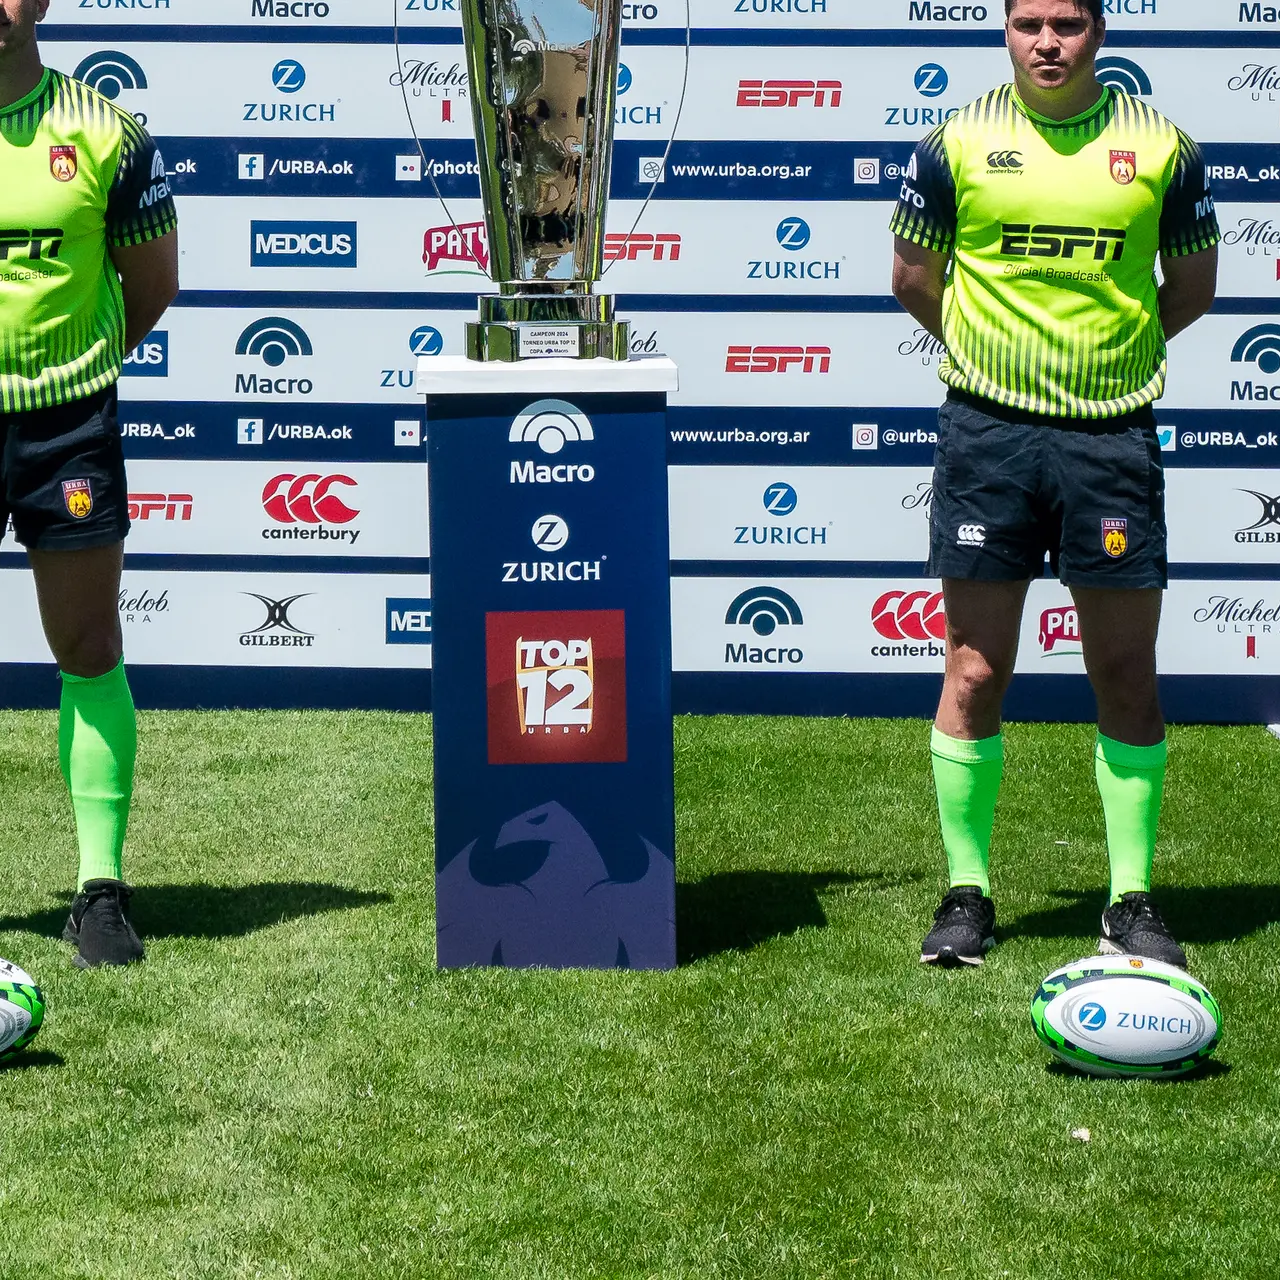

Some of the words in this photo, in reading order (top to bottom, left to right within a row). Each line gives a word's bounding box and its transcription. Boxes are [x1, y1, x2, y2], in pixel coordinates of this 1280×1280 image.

[908, 0, 988, 22] Macro
[736, 80, 842, 108] ESPN
[242, 102, 335, 122] ZURICH
[268, 158, 355, 177] /URBA.ok
[671, 159, 812, 180] www.urba.org.ar
[254, 233, 352, 256] MEDICUS
[1000, 223, 1127, 262] ESPN
[747, 261, 840, 280] ZURICH
[1003, 263, 1044, 279] Official
[1045, 267, 1113, 283] Broadcaster
[725, 346, 832, 374] ESPN
[234, 373, 314, 395] Macro
[268, 424, 353, 442] /URBA.ok
[670, 427, 810, 447] www.urba.org.ar
[1181, 431, 1278, 449] @URBA_ok
[509, 460, 595, 484] Macro
[261, 524, 361, 545] canterbury
[734, 526, 827, 546] ZURICH
[501, 560, 601, 583] ZURICH
[238, 634, 315, 648] GILBERT
[520, 639, 590, 668] TOP
[724, 642, 804, 664] Macro
[516, 669, 594, 726] 12
[527, 726, 587, 734] URBA
[1116, 1011, 1192, 1035] ZURICH
